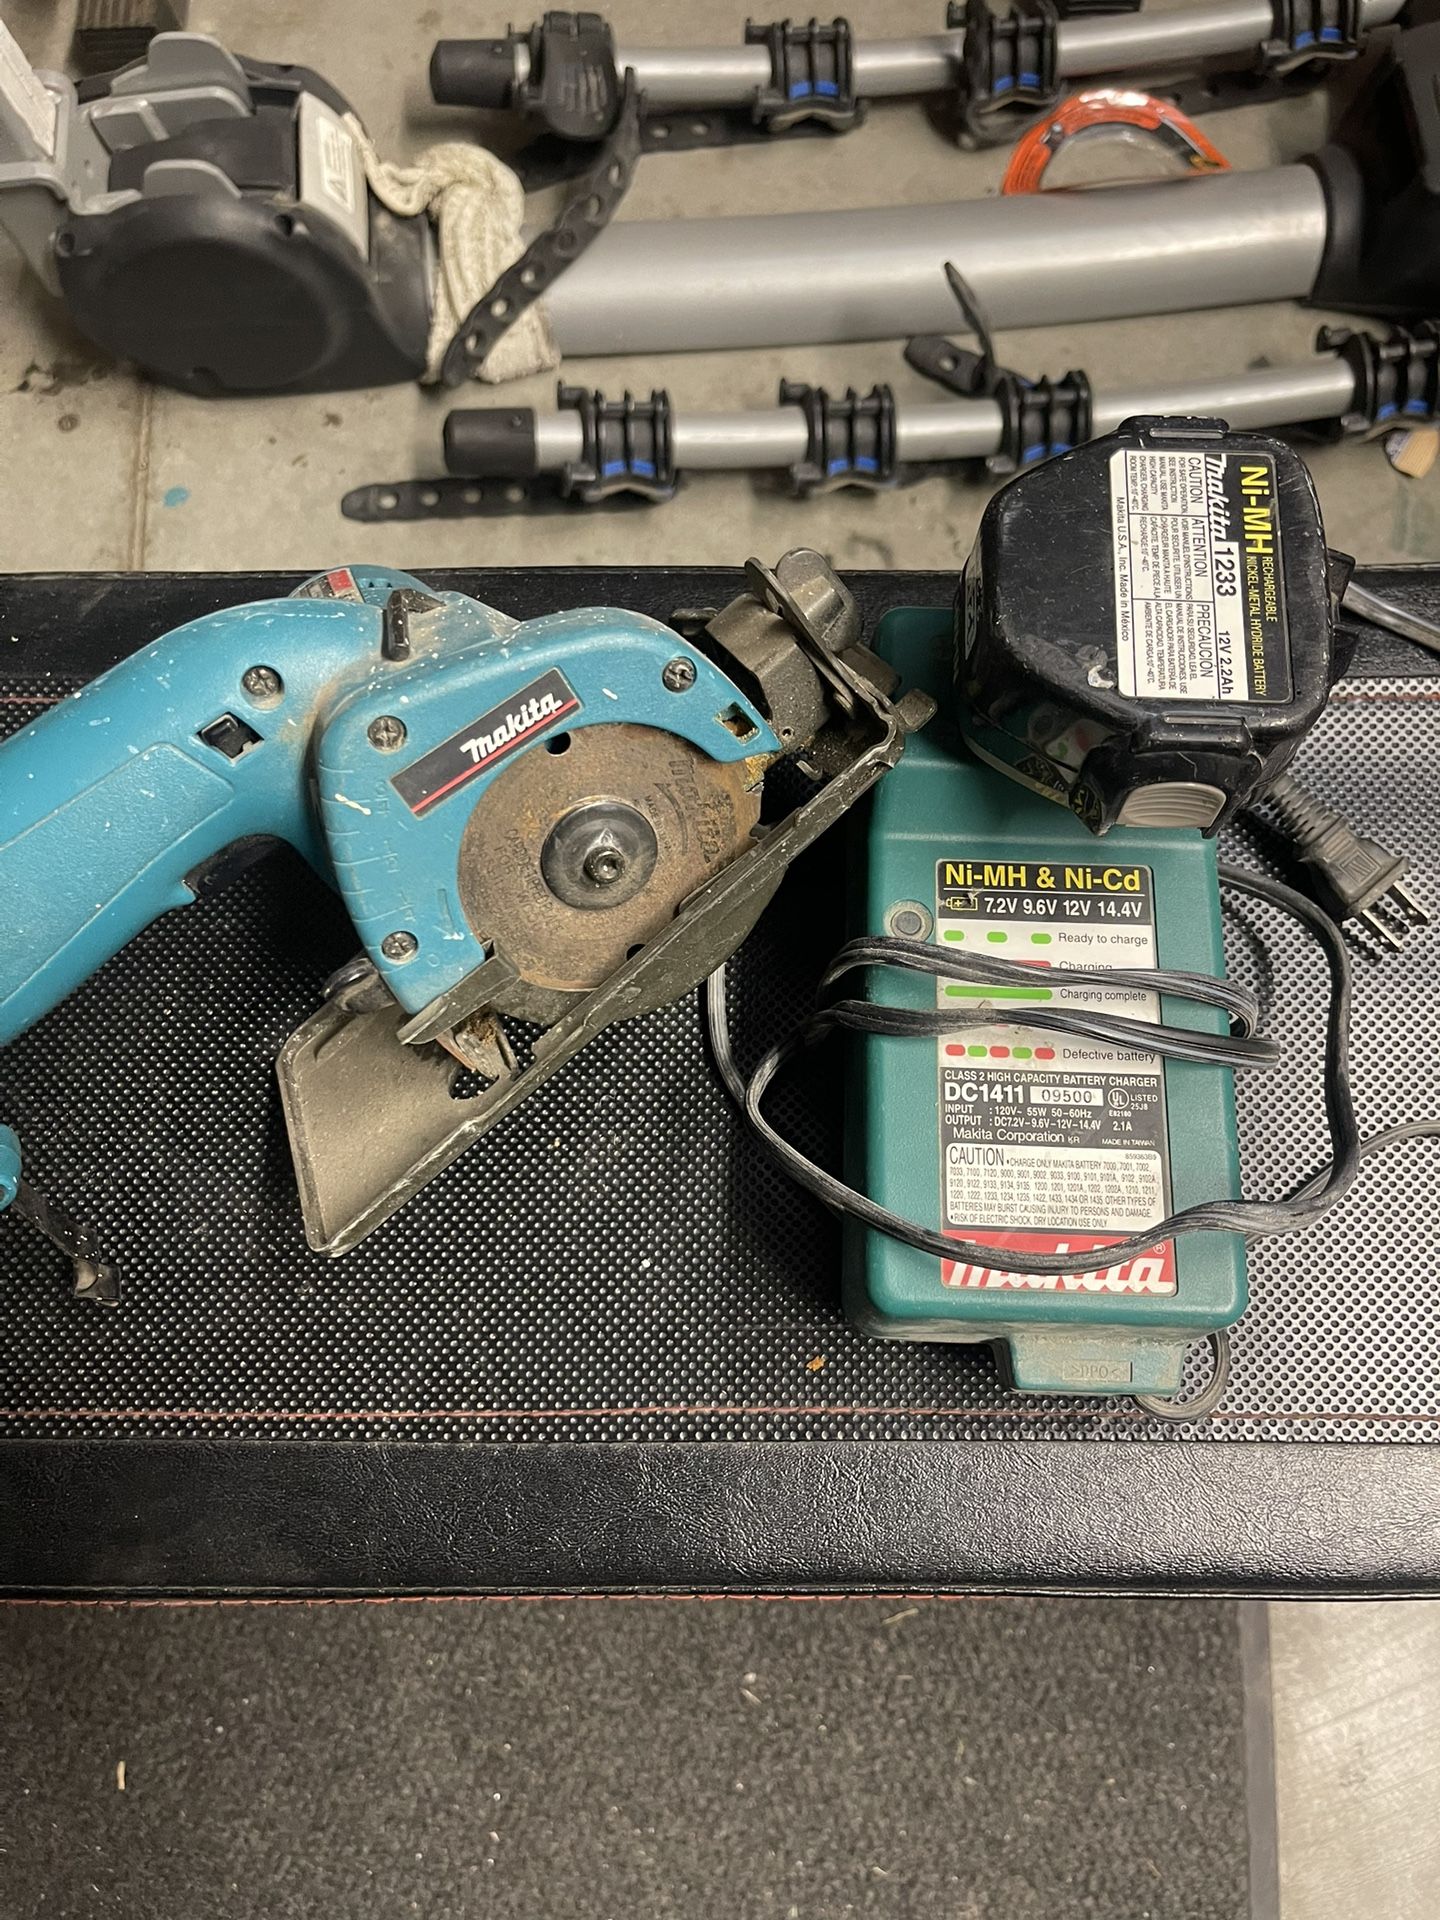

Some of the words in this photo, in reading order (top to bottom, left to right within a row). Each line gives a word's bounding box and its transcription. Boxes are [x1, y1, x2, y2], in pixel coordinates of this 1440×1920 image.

[1188, 457, 1203, 503] CAUTION
[1115, 496, 1126, 523] Makita
[1239, 466, 1273, 553] Ni-MH
[1191, 518, 1207, 576] ATTENTION
[1118, 556, 1128, 572] Inc.
[1213, 547, 1236, 596] 1233
[1118, 574, 1129, 597] Made
[1245, 555, 1261, 616] NICKEL-METAL
[1261, 556, 1277, 621] RECHARGEABLE
[1120, 610, 1131, 641] México
[1195, 604, 1217, 677] PRECAUCIÓN
[1218, 630, 1231, 653] 12V
[1249, 618, 1263, 657] HYDRIDE
[1219, 657, 1234, 694] 2.2Ah
[1252, 658, 1266, 696] BATTERY
[945, 863, 1026, 888] Ni-MH
[1035, 865, 1055, 888] &
[1065, 866, 1140, 891] Ni-Cd
[984, 897, 1017, 914] 7.2V
[1022, 898, 1057, 915] 9.6V
[1063, 899, 1090, 916] 12V
[1097, 900, 1142, 917] 14.4V
[1058, 932, 1092, 945] Ready
[1096, 934, 1107, 943] to
[1109, 934, 1148, 946] charge
[1060, 989, 1102, 1002] Charging
[1105, 991, 1147, 1003] complete
[1062, 1049, 1113, 1061] Defective
[1117, 1051, 1156, 1064] battery
[944, 1070, 977, 1081] CLASS
[978, 1071, 984, 1081] 2
[987, 1071, 1011, 1082] HIGH
[1013, 1072, 1060, 1084] CAPACITY
[1063, 1073, 1106, 1085] BATTERY
[1108, 1075, 1157, 1086] CHARGER
[944, 1081, 1023, 1103] DC1411
[1041, 1088, 1092, 1103] 09500
[1130, 1093, 1158, 1102] LISTED
[944, 1103, 974, 1114] INPUT
[1026, 1105, 1046, 1116] 55W
[945, 1114, 982, 1125] OUTPUT
[1112, 1120, 1132, 1131] 2.1A
[953, 1126, 992, 1139] Makita
[996, 1128, 1064, 1144] Corporation
[949, 1145, 1004, 1166] CAUTION
